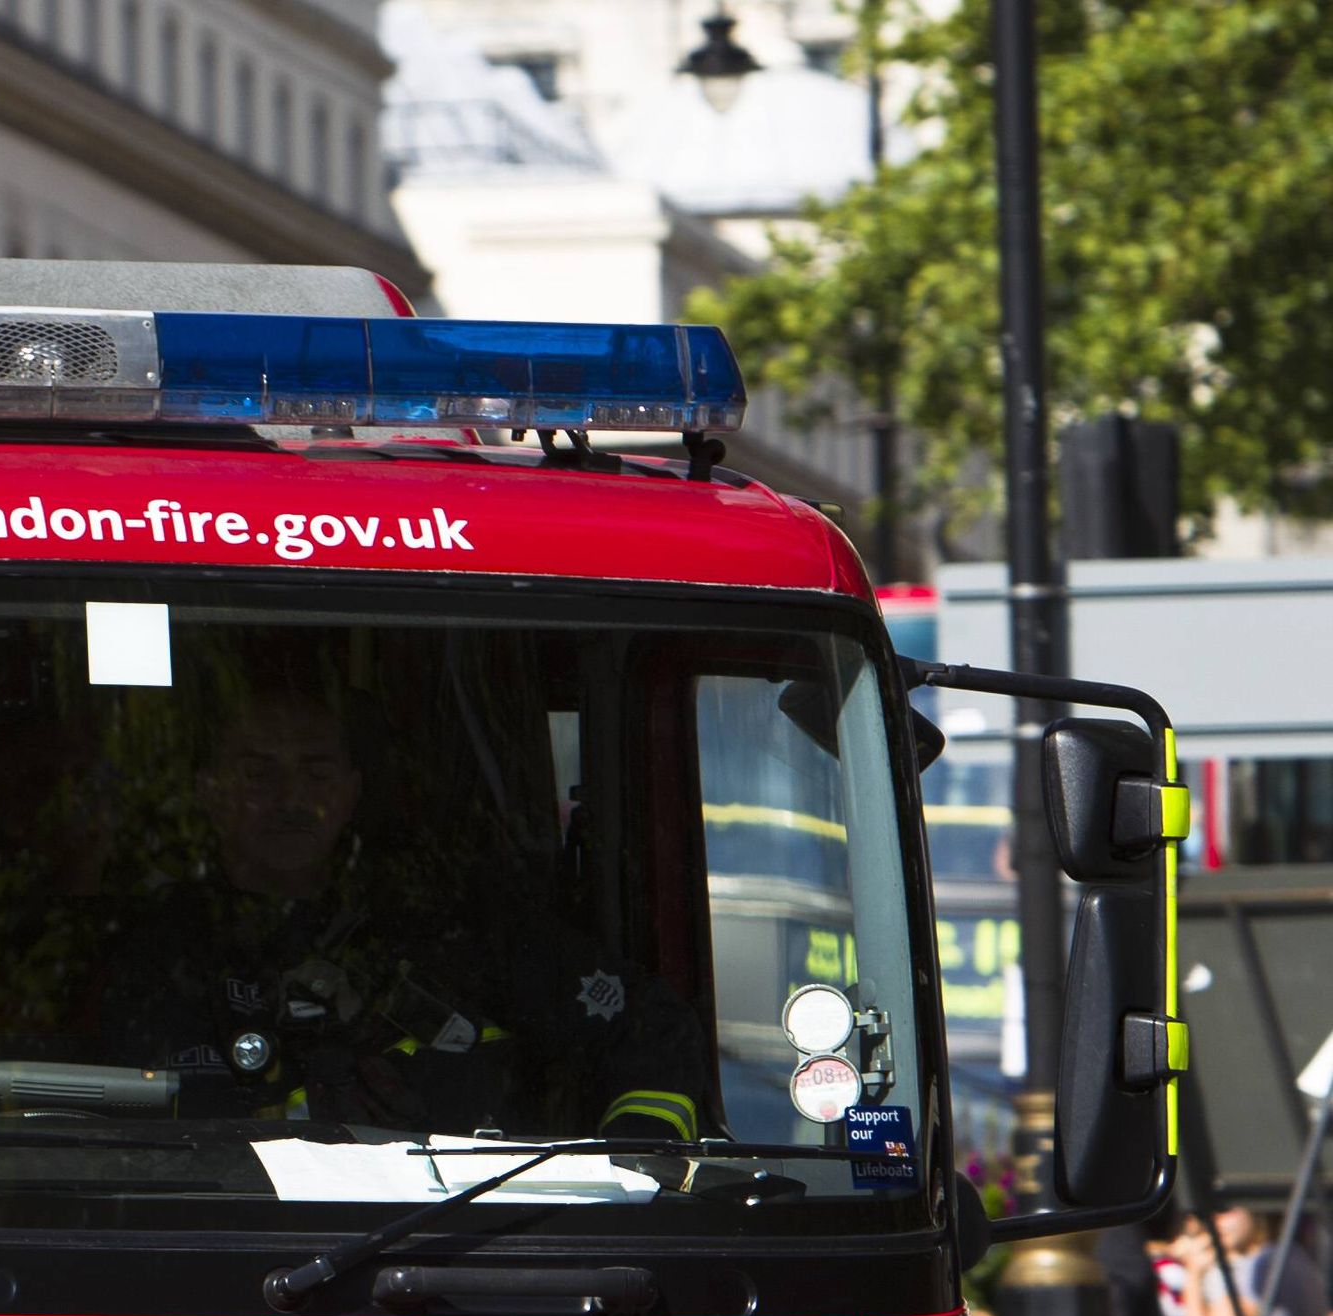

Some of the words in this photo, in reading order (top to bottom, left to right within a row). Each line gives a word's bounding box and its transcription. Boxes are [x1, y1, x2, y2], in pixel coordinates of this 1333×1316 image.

[813, 1067, 835, 1085] 08
[848, 1109, 900, 1126] Support
[850, 1129, 874, 1140] our
[855, 1161, 914, 1177] Lifeboats
